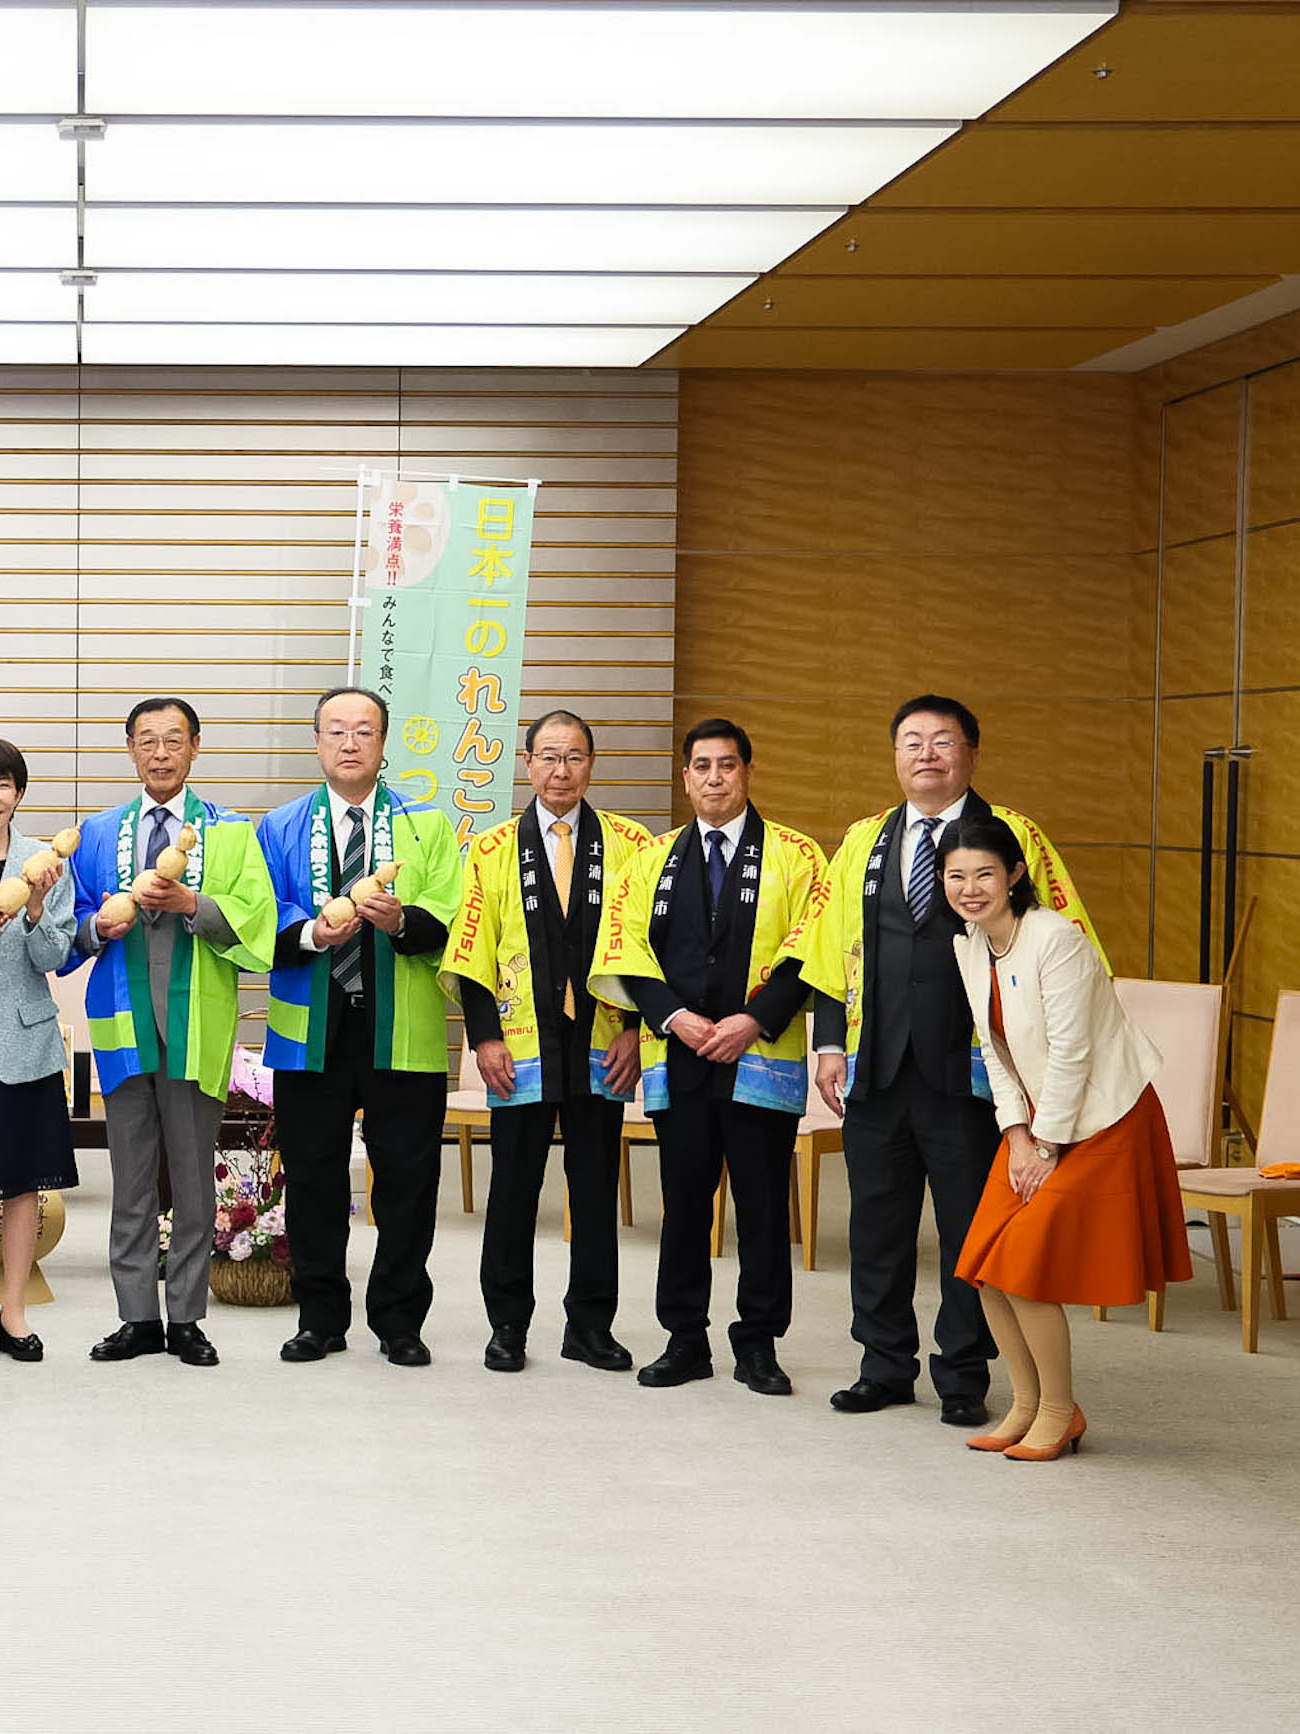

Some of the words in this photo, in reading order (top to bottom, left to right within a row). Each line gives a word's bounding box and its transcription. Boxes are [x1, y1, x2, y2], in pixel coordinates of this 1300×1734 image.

[378, 596, 397, 712] みんなで食べ
[521, 848, 539, 912] 土浦市
[588, 841, 603, 905] 土浦市
[654, 855, 679, 917] 土浦市
[740, 845, 760, 903] 土浦市
[864, 832, 888, 896] 土浦市
